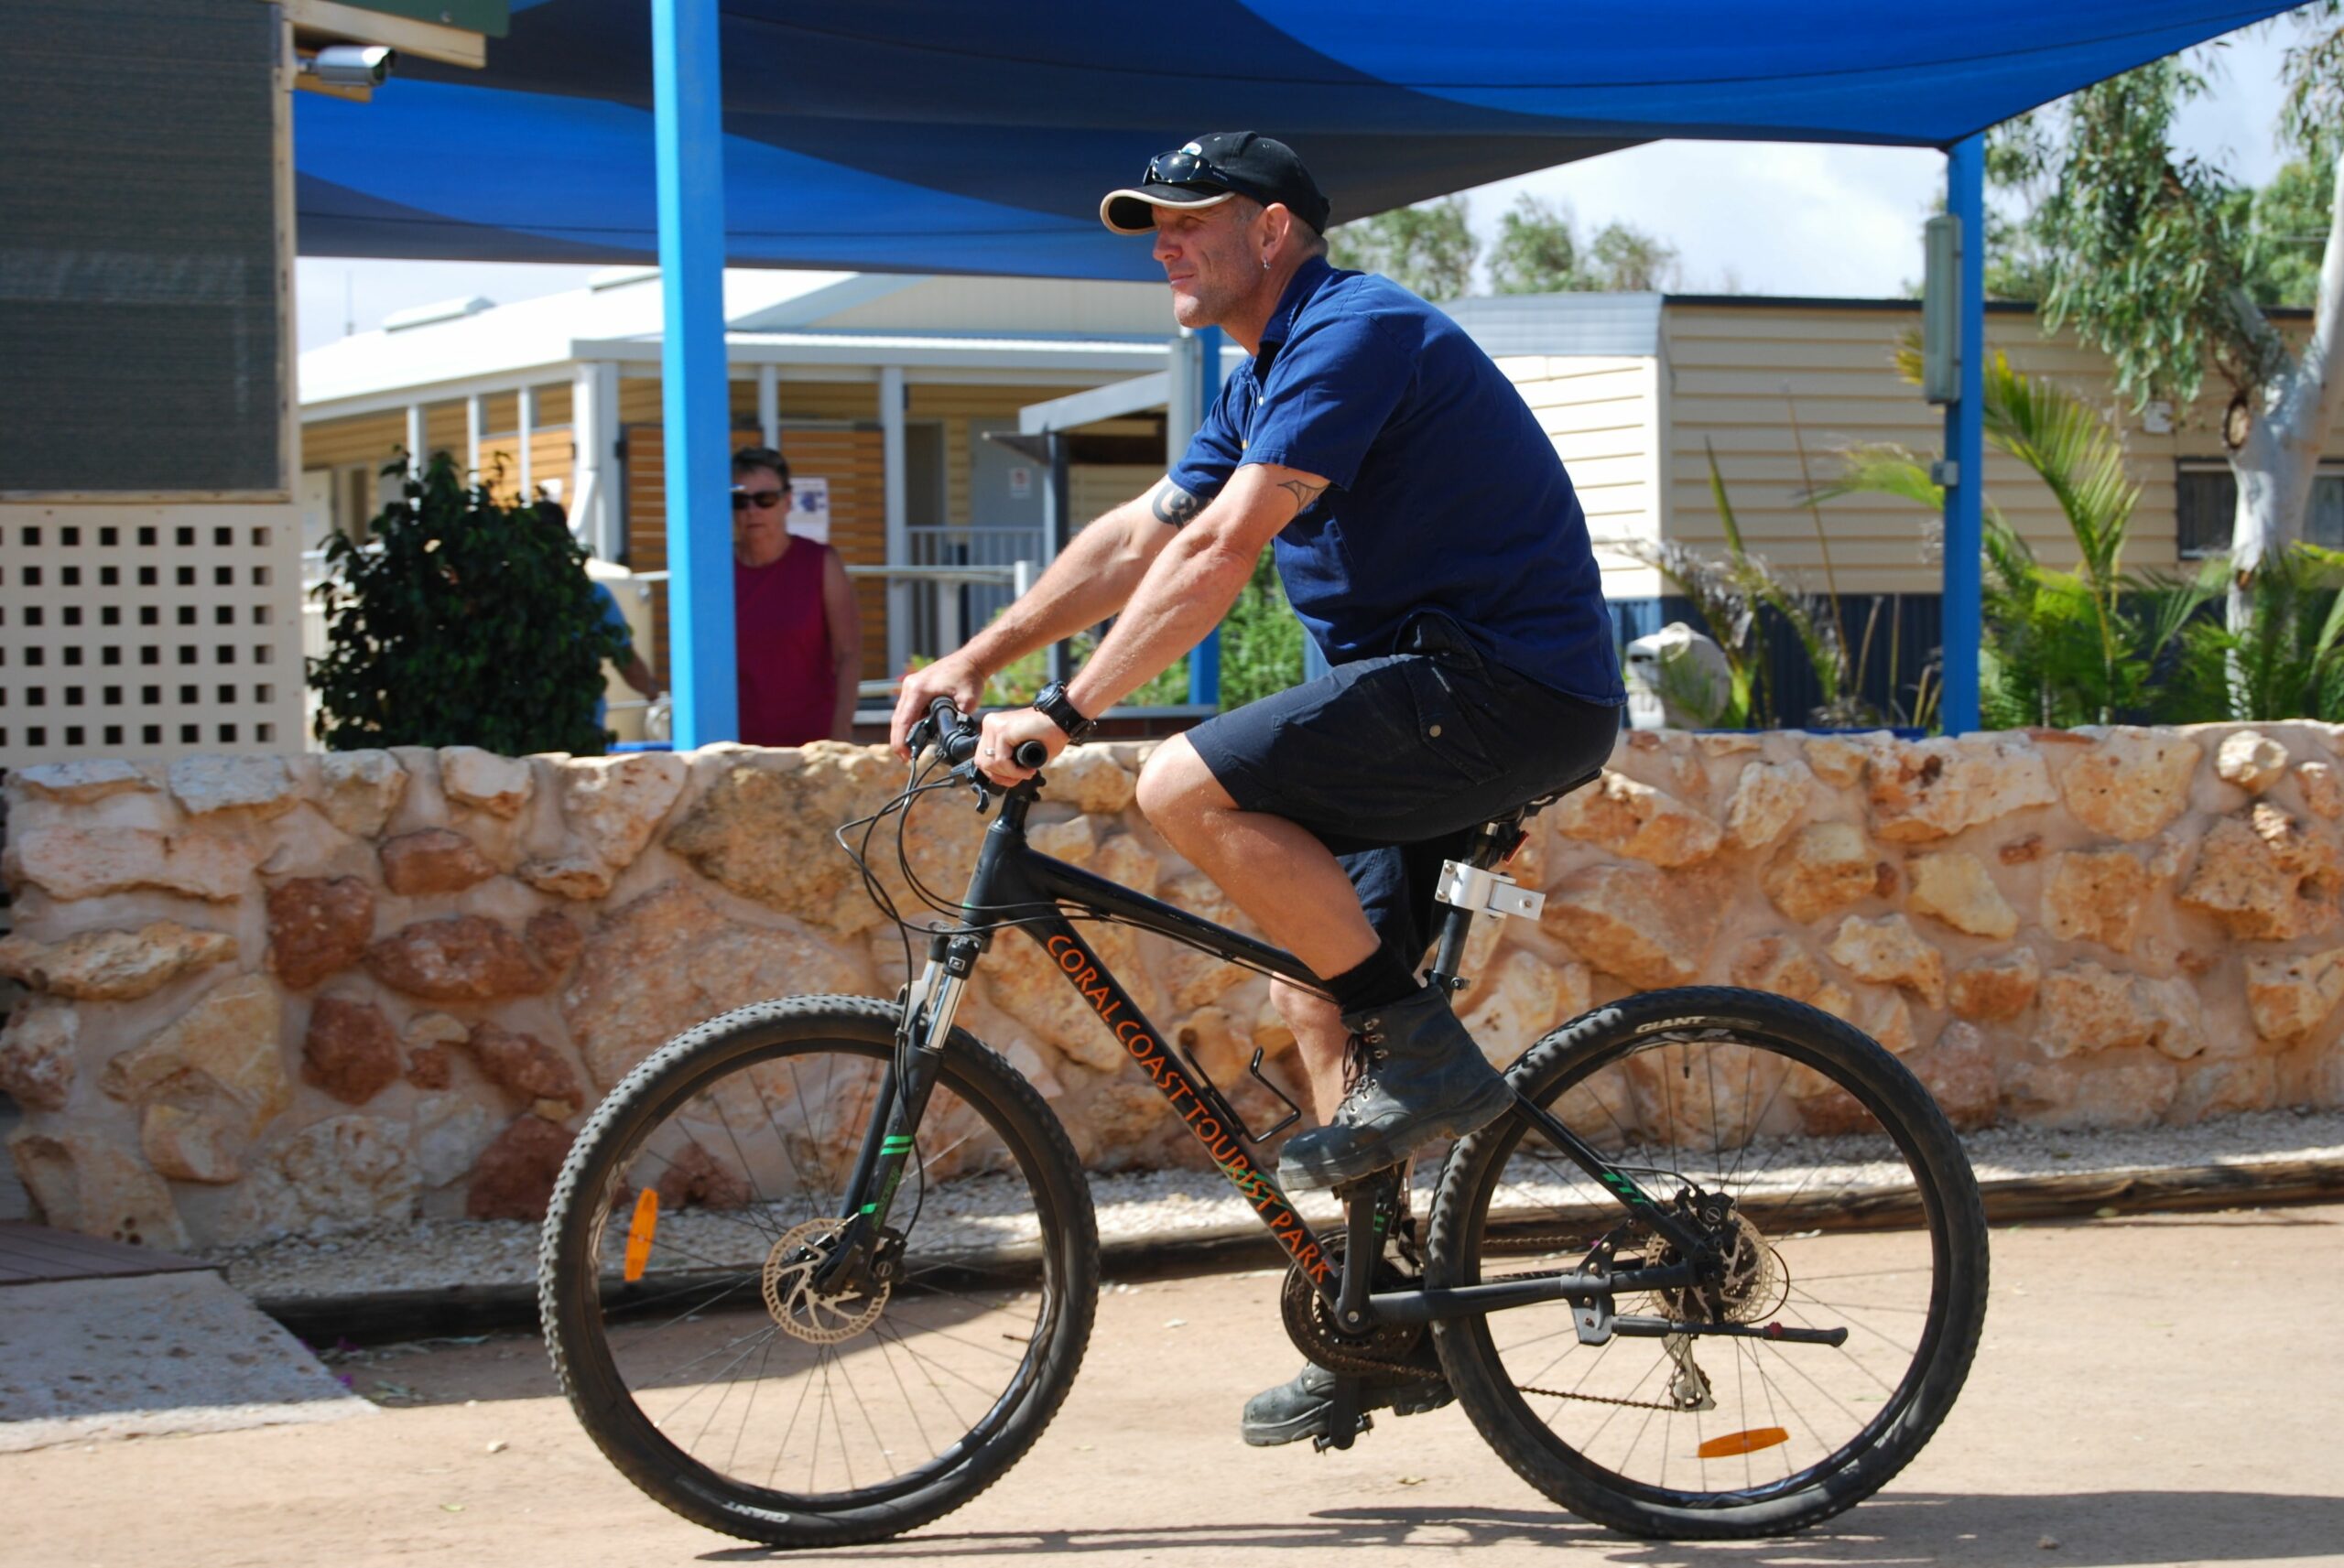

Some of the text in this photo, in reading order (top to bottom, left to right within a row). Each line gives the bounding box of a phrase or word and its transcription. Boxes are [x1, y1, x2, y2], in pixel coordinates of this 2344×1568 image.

[1046, 935, 1333, 1283] CORAL COAST TOURIST PARK
[1634, 1015, 1707, 1034] GIANT
